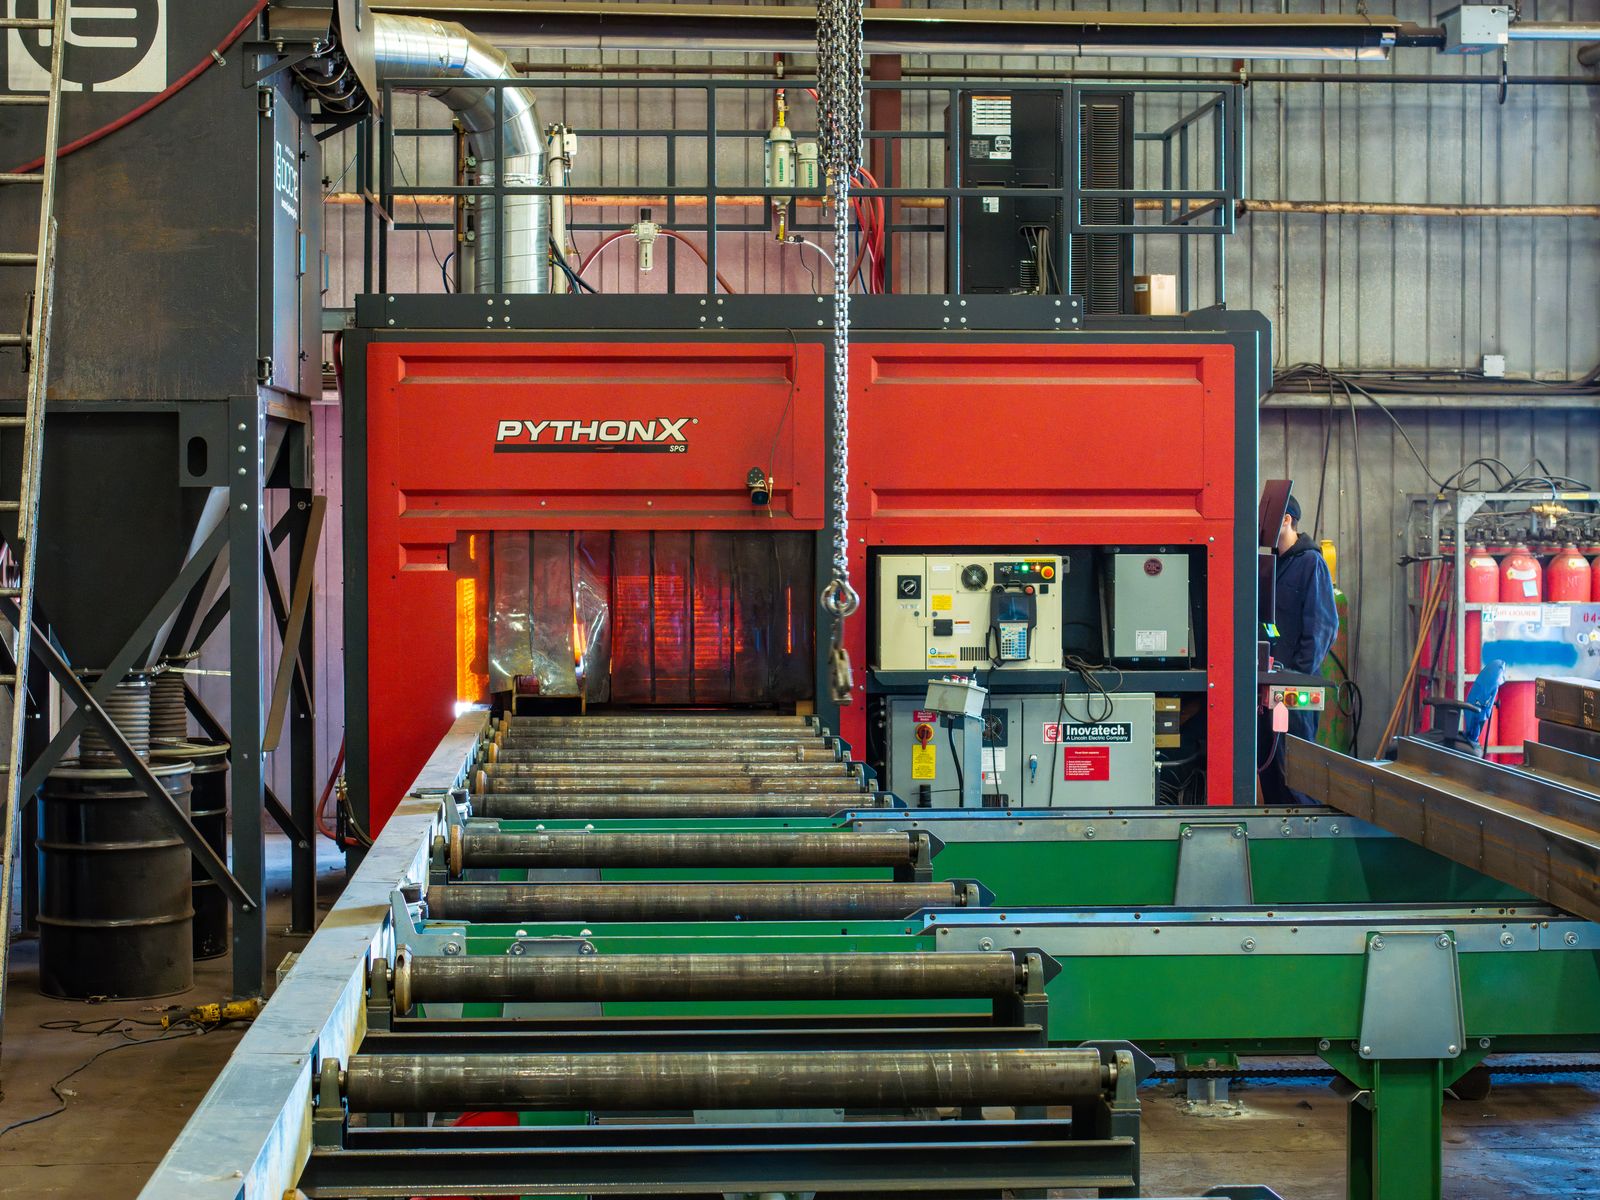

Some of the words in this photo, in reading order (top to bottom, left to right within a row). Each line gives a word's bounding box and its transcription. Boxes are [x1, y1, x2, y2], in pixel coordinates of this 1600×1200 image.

[496, 417, 690, 442] PYTHONX
[669, 445, 685, 453] SPG
[1066, 724, 1125, 736] Inovatech
